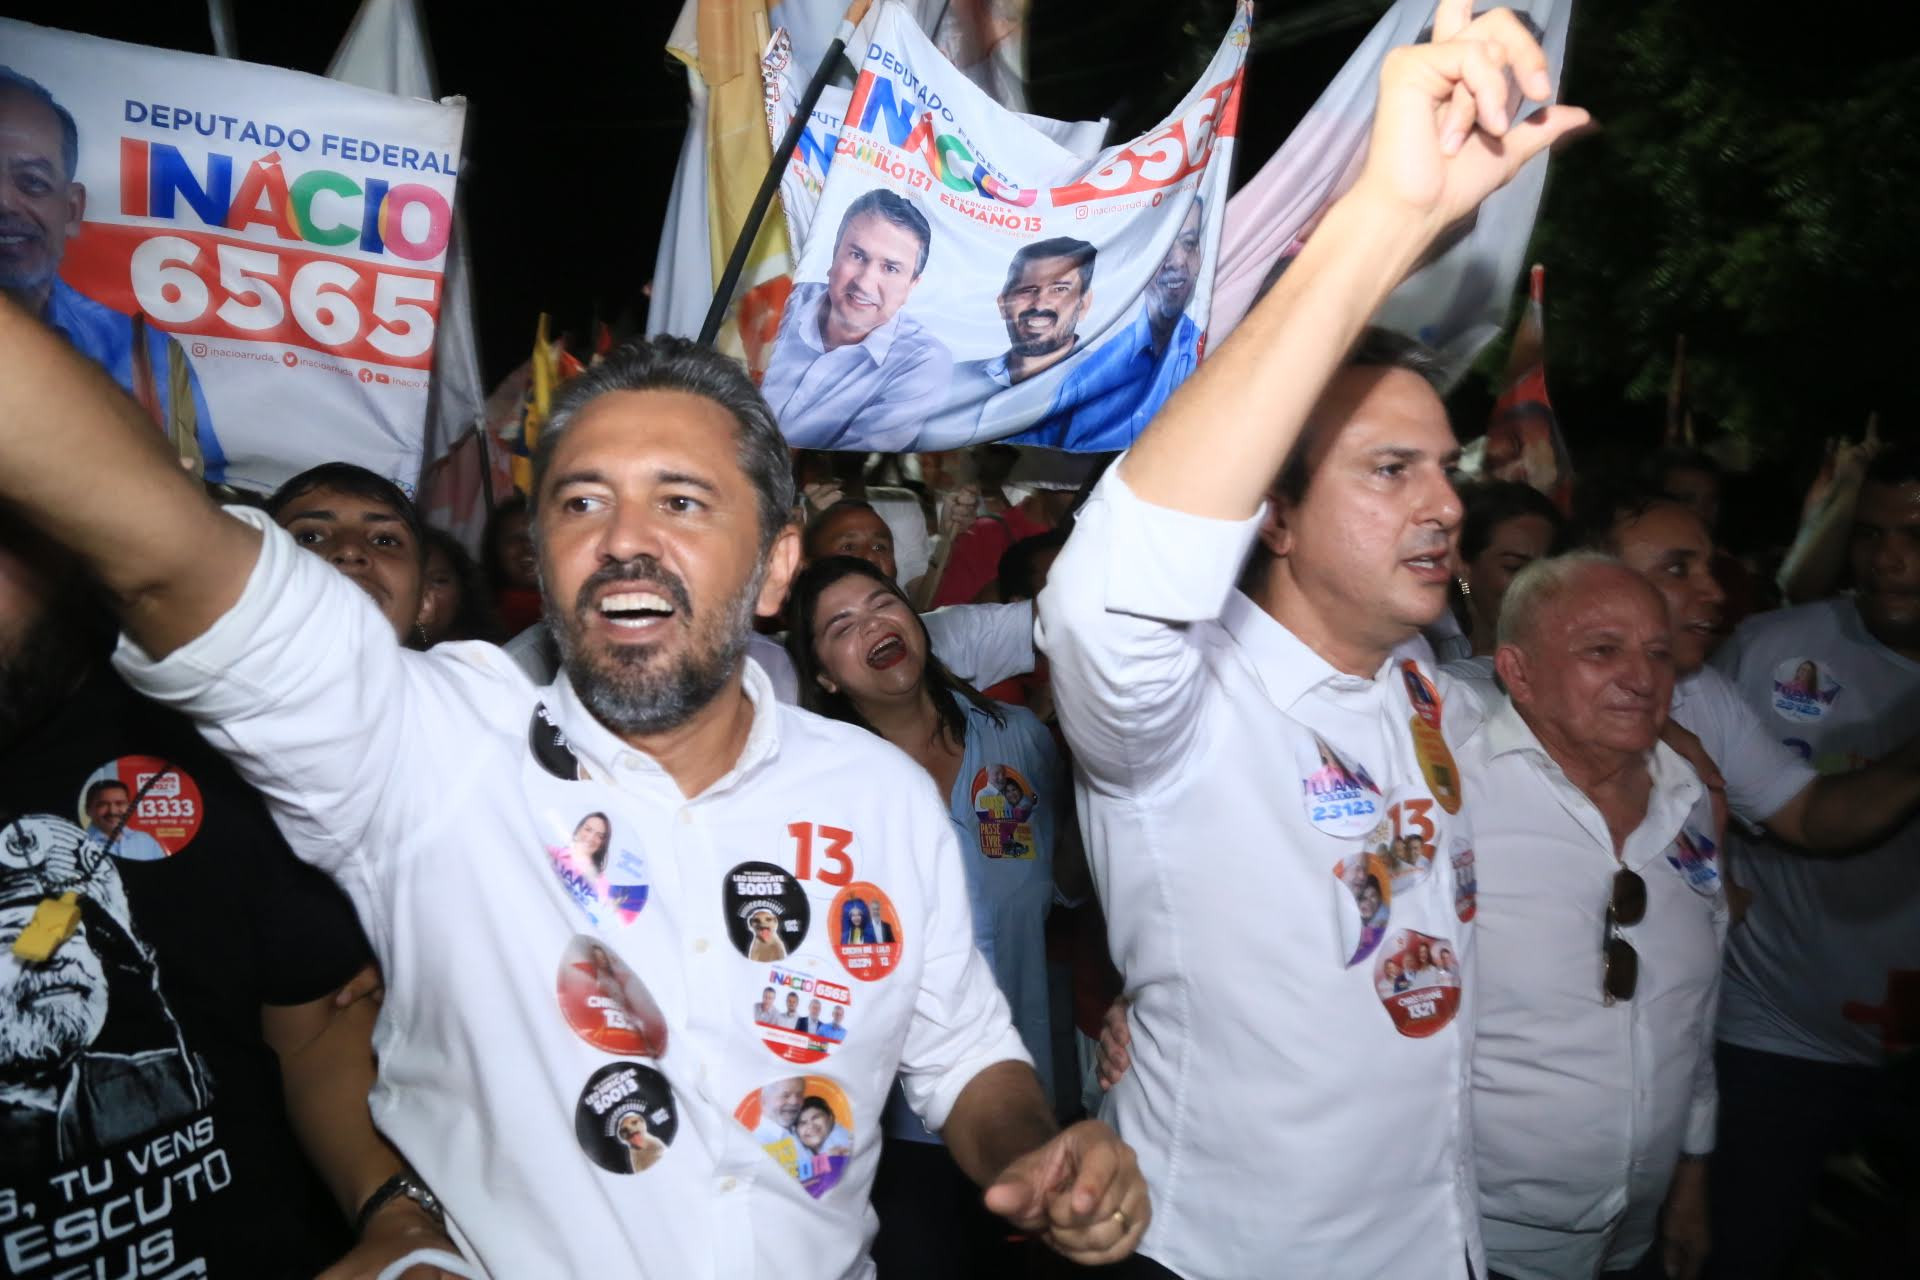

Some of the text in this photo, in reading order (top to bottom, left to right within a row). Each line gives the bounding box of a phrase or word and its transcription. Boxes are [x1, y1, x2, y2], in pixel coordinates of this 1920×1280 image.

[124, 100, 457, 176] DEPUTADO FEDERAL
[867, 43, 954, 123] DEPUTADO
[957, 127, 1020, 191] FEDERA
[835, 137, 906, 180] CAMILO
[120, 150, 452, 262] INÁCIO
[940, 193, 1021, 230] ELMANO
[1023, 216, 1042, 232] 13
[130, 235, 435, 358] 6565
[137, 799, 195, 819] 13333
[1312, 800, 1375, 821] 23123
[1386, 798, 1436, 843] 13
[787, 821, 855, 887] 13
[737, 882, 783, 896] 50013
[50, 1158, 114, 1203] TU
[127, 1115, 214, 1176] VENS
[3, 1148, 233, 1275] ESCUTO
